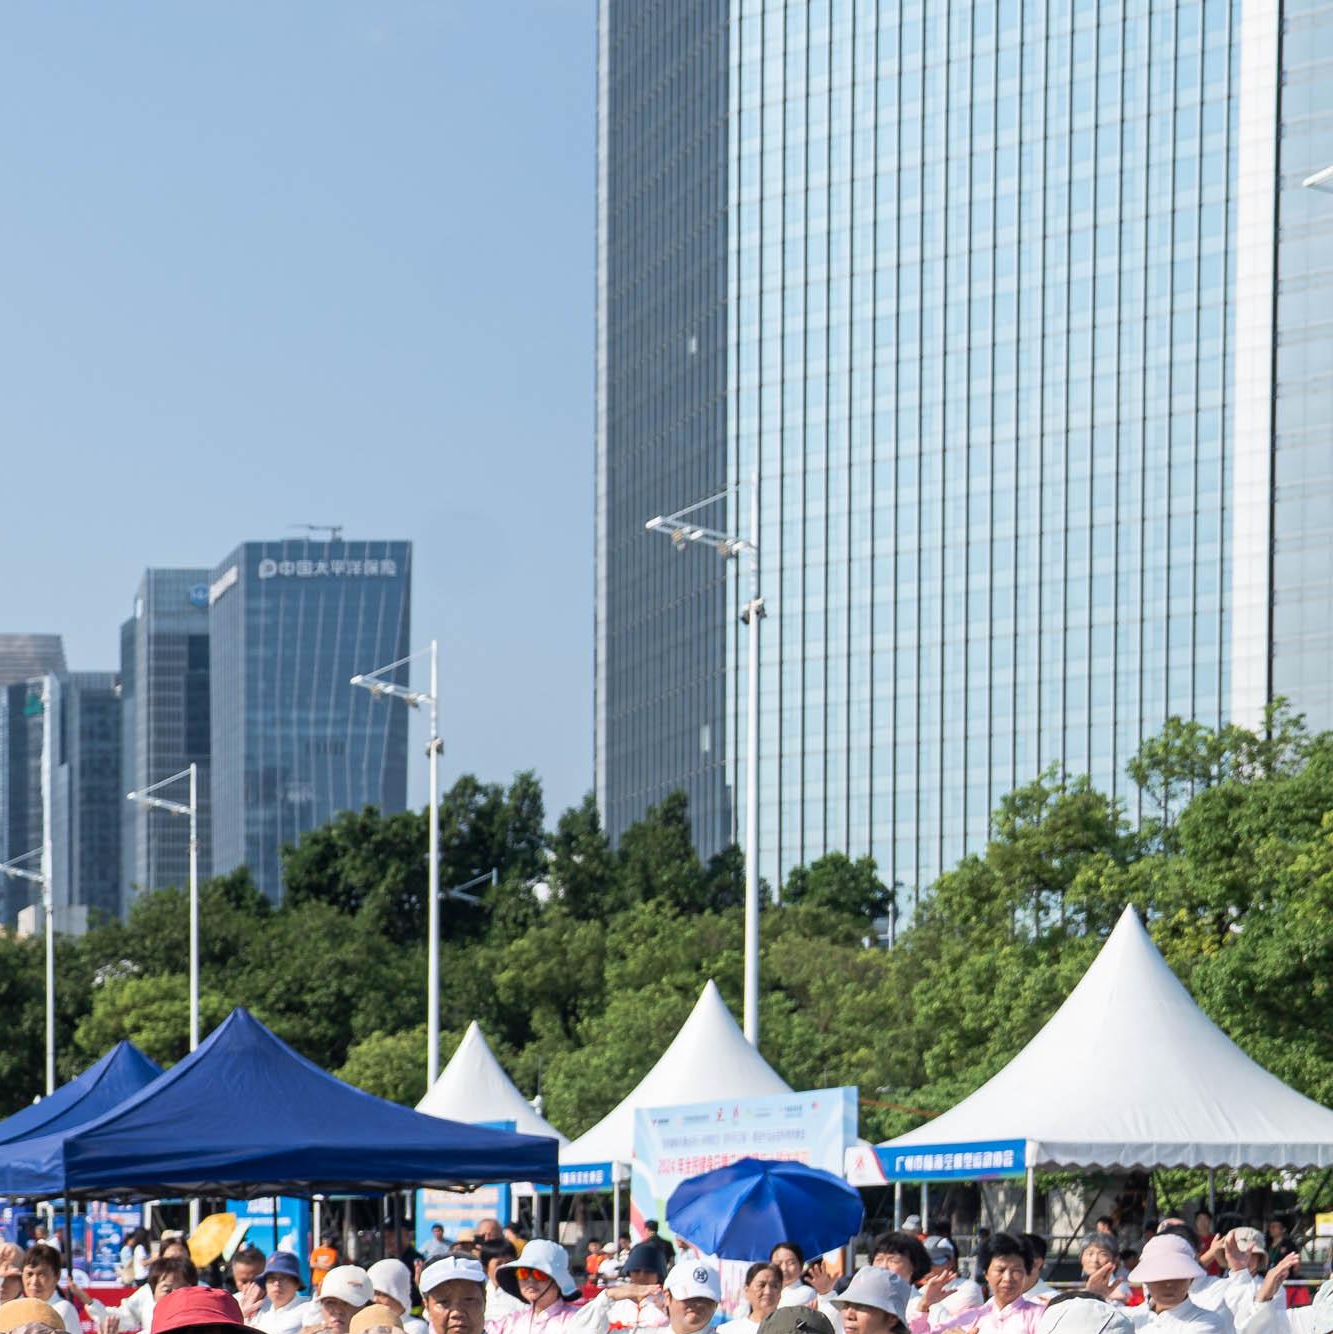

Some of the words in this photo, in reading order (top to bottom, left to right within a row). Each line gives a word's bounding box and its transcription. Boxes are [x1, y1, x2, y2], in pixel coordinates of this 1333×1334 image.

[278, 558, 398, 578] 中国太平洋保险
